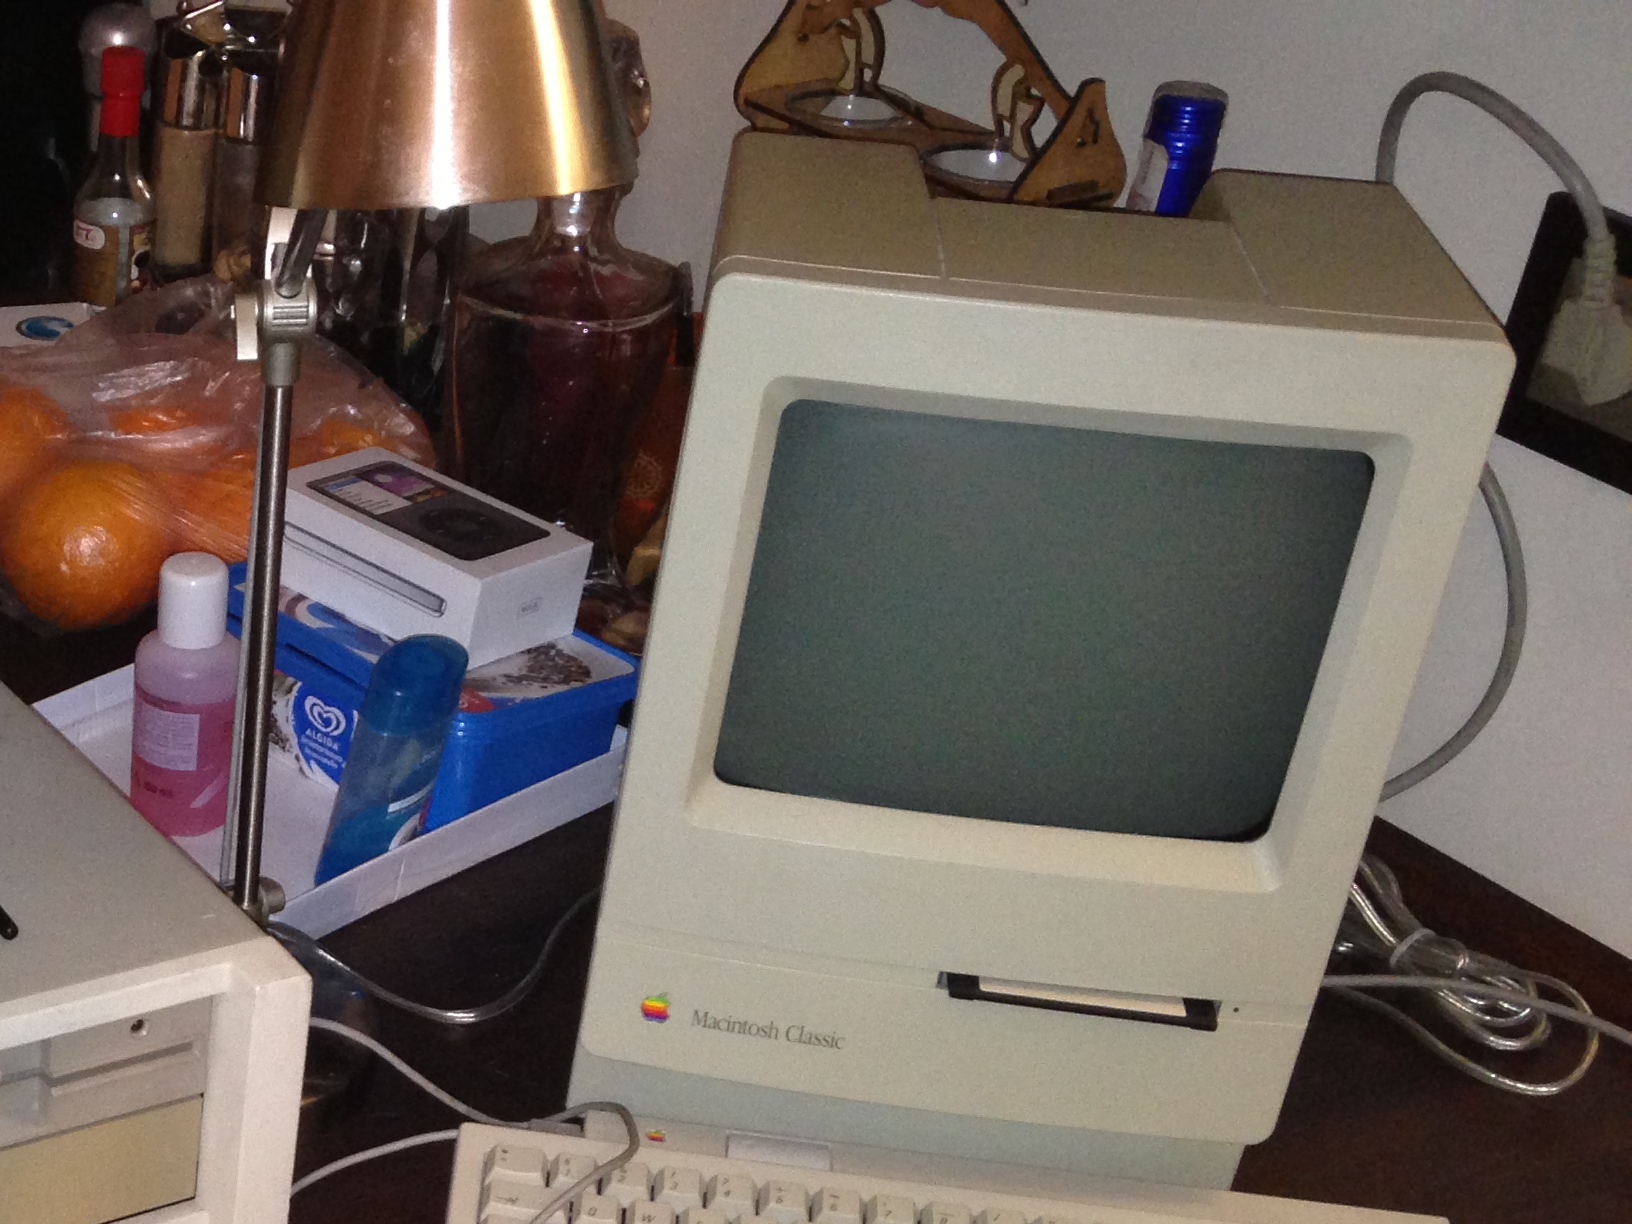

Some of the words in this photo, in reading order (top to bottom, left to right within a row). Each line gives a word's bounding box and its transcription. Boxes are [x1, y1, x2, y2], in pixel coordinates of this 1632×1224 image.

[305, 728, 339, 751] ALGIDA
[691, 1009, 780, 1040] Macintosh
[786, 1025, 846, 1050] Classic
[641, 1213, 656, 1222] W
